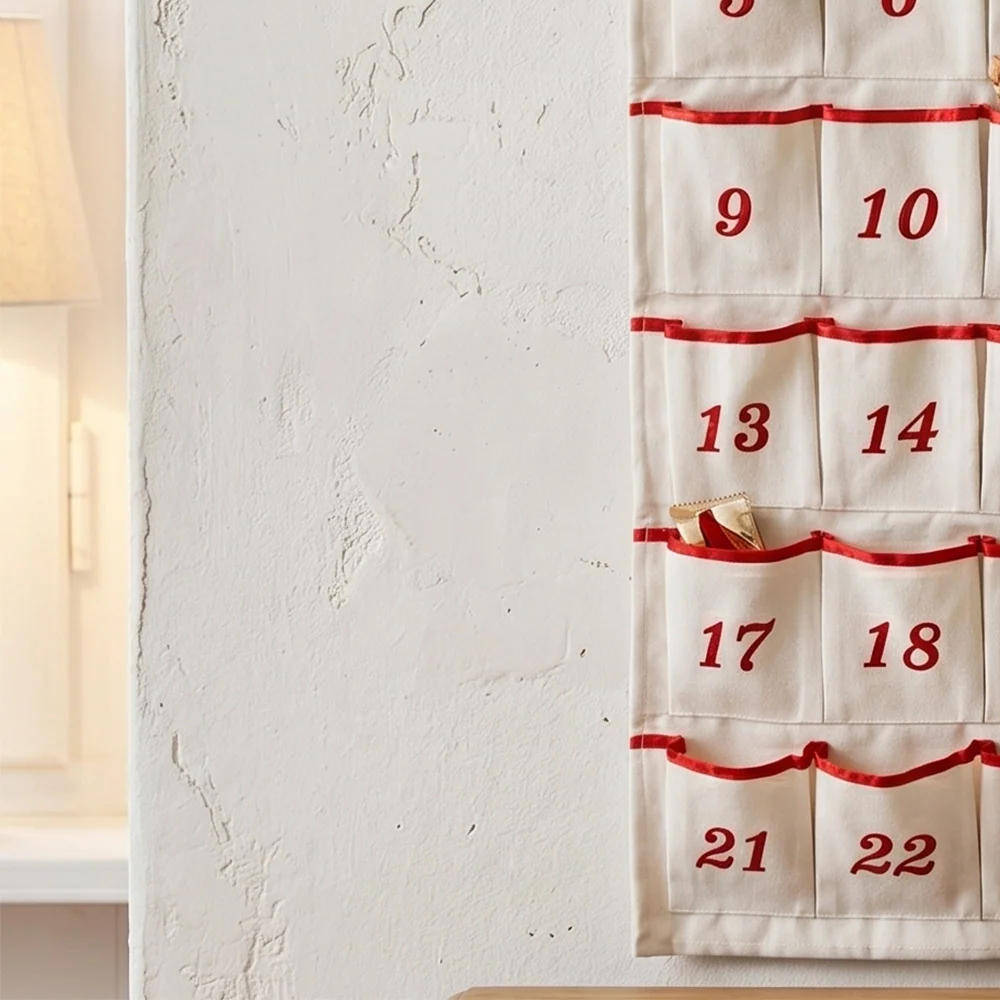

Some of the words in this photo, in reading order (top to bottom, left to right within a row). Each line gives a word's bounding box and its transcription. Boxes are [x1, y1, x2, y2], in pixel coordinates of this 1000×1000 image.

[714, 187, 753, 238] 9
[858, 187, 939, 240] 10
[698, 401, 770, 453] 13
[863, 401, 938, 455] 14
[700, 619, 776, 672] 17
[863, 621, 942, 672] 18
[696, 827, 768, 873] 21
[851, 832, 937, 876] 22
